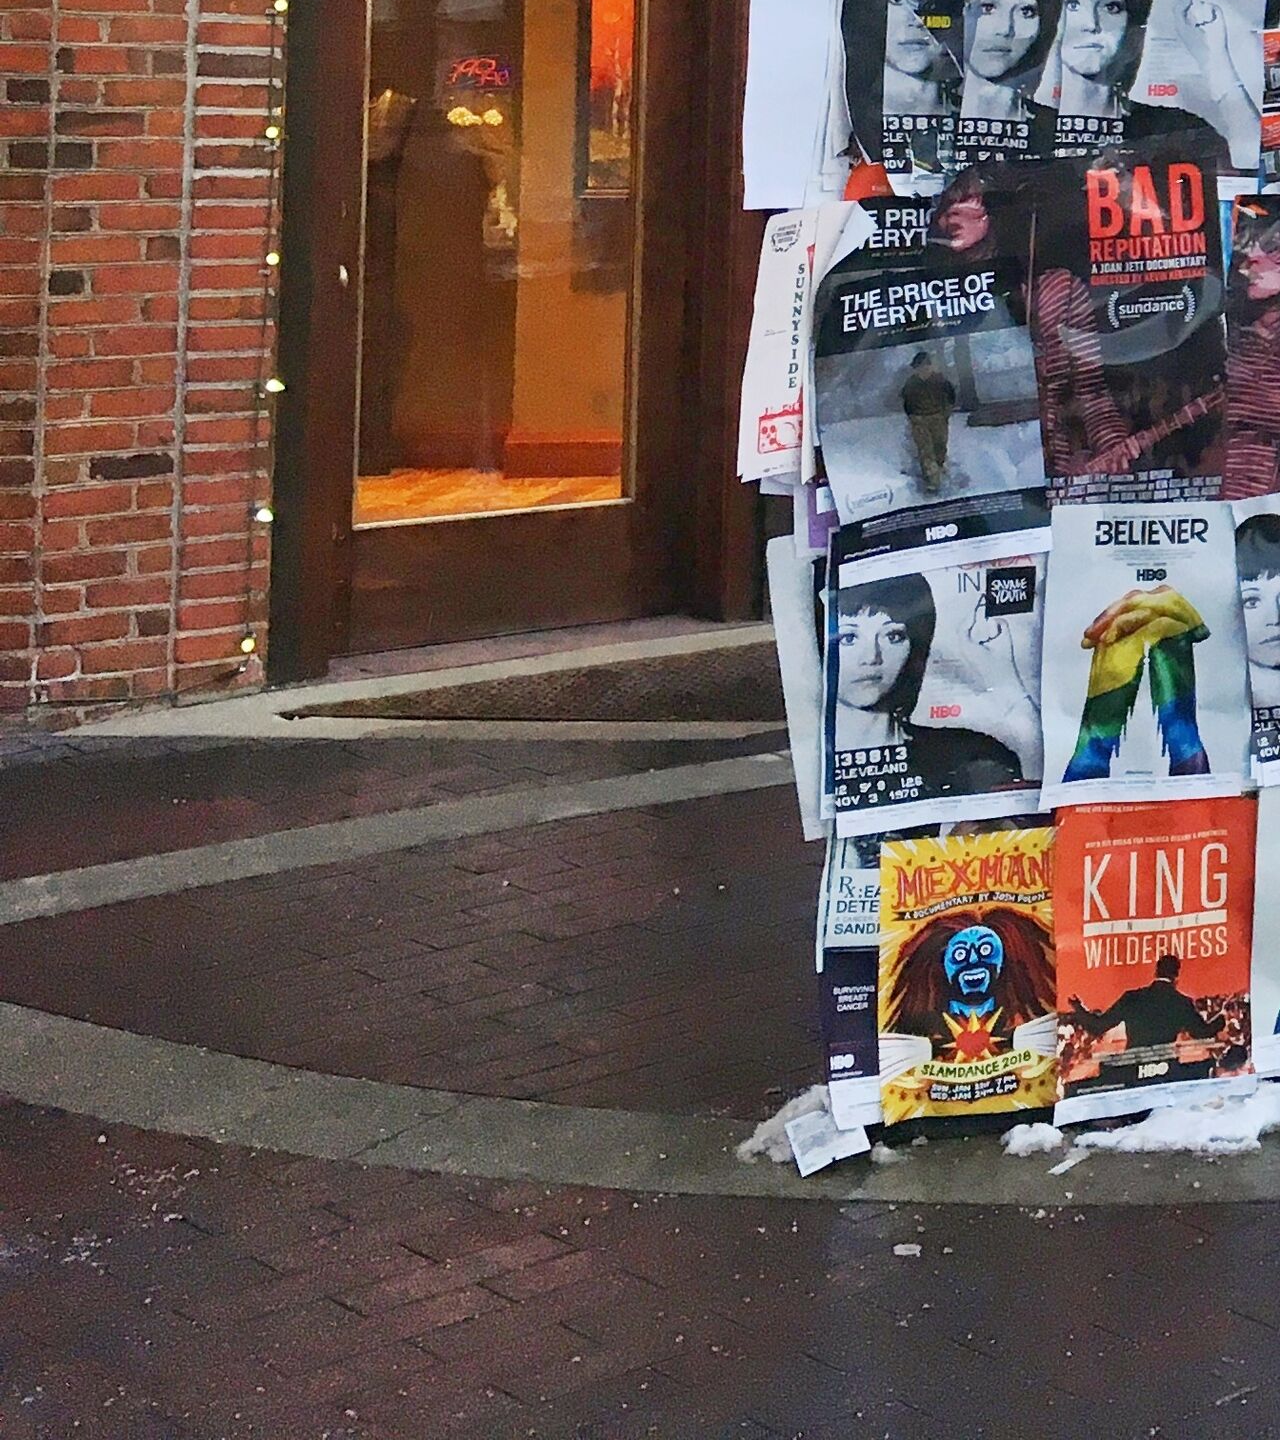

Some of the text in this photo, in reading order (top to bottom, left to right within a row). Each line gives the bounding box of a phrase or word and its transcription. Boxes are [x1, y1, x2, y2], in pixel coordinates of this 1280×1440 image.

[1147, 85, 1178, 97] HBO
[958, 119, 1030, 138] 139813
[1055, 117, 1124, 134] 139813
[957, 135, 1029, 150] CLEVELAND
[1086, 162, 1206, 239] BAD
[1089, 231, 1207, 262] REPUTATION
[1091, 255, 1207, 274] A JOAN JETT DOCUMENTARY
[840, 271, 995, 313] THE PRICE OF
[843, 291, 995, 333] EVERYTHING
[1118, 299, 1185, 315] sundance
[788, 263, 805, 389] SUNNYSIDE
[925, 523, 959, 542] HBO
[1095, 518, 1209, 546] BELIEVER
[958, 571, 981, 594] IN
[1136, 568, 1167, 581] HBO
[992, 589, 1027, 604] YOUTH
[930, 704, 961, 719] HBO
[835, 762, 908, 780] CLEVELAND
[889, 788, 919, 801] 1970
[1083, 842, 1229, 922] KING
[904, 912, 911, 920] A
[913, 895, 974, 919] DOCUMENTARY
[978, 892, 989, 902] BY
[1083, 925, 1228, 969] WILDERNESS
[832, 984, 876, 996] SURVIVING
[837, 994, 869, 1003] BREAST
[836, 1002, 869, 1012] CANCER
[829, 1054, 855, 1071] HBO
[920, 1050, 1032, 1078] SLAMDANCE 2018
[1138, 1061, 1170, 1079] HBO
